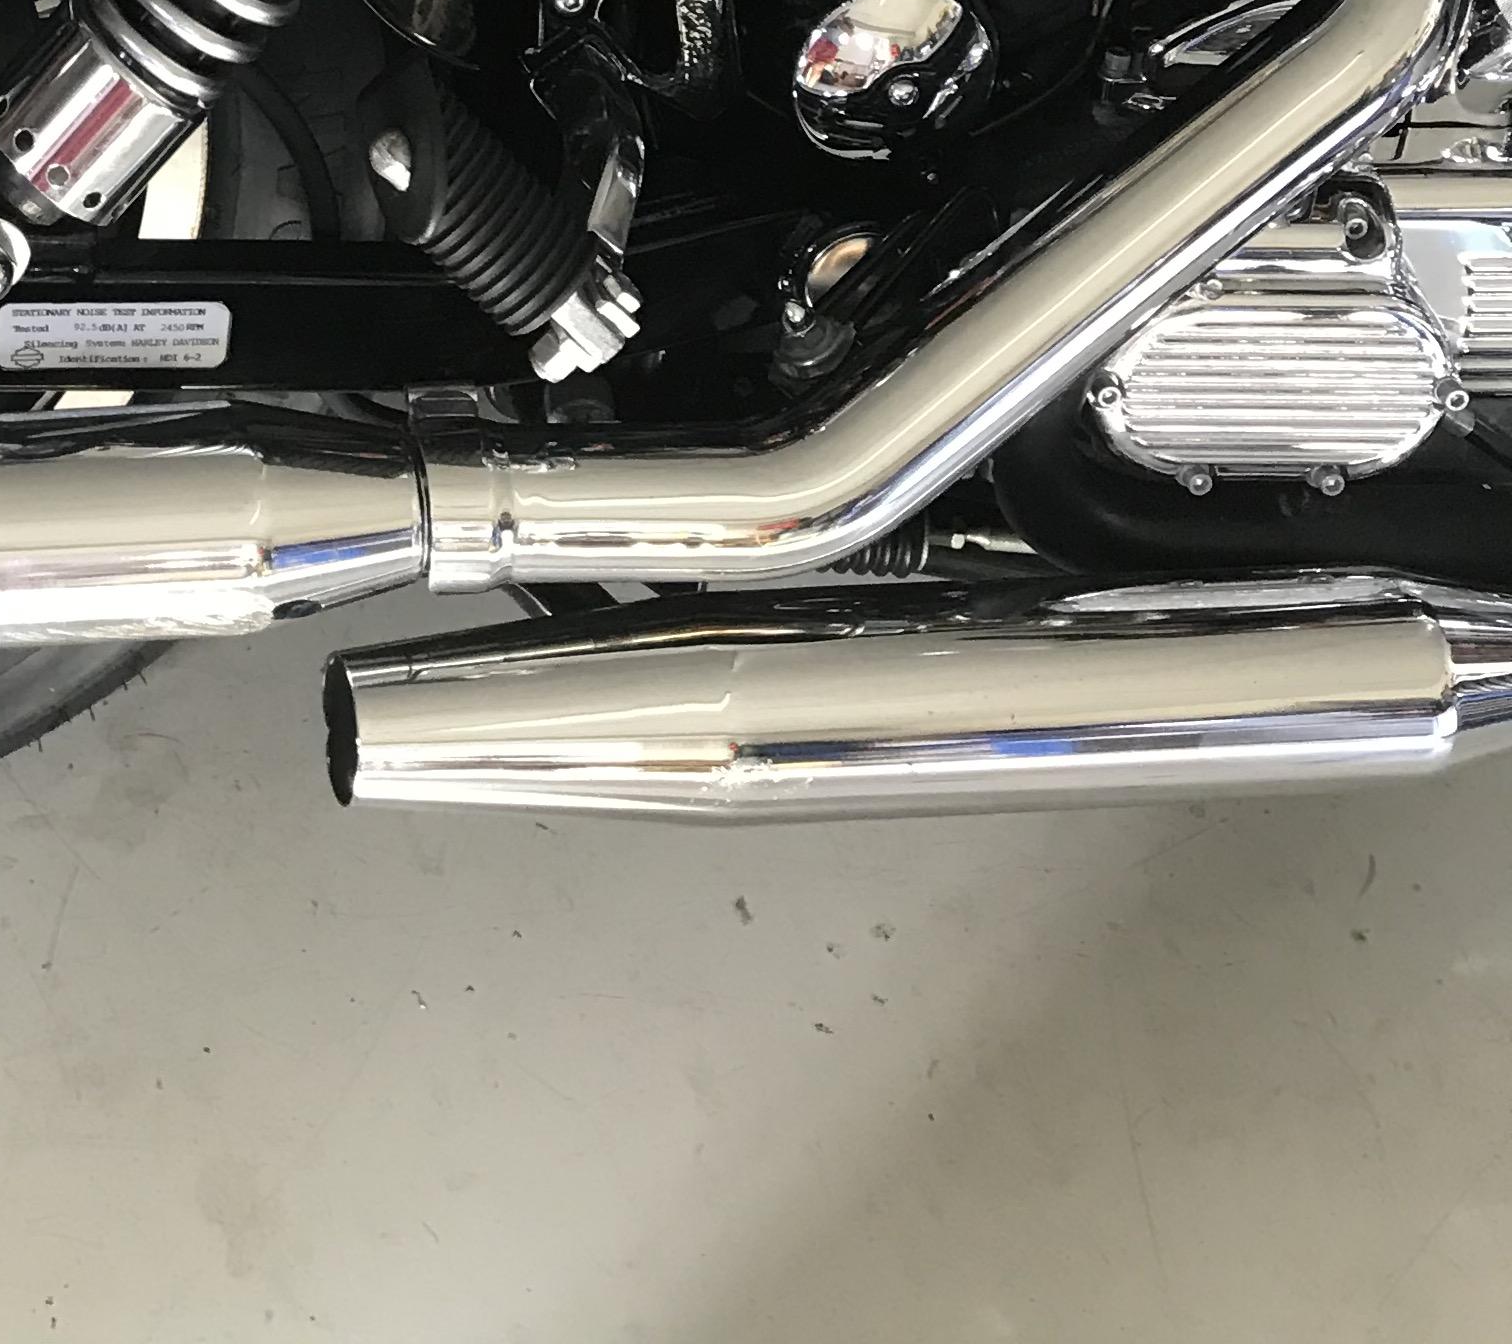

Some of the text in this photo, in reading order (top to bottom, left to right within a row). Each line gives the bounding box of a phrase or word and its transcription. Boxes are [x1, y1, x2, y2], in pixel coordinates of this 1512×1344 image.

[12, 308, 207, 317] STATIONARY NOISE TEST INFORMATION
[12, 324, 49, 333] Tested
[24, 340, 78, 349] Silencing
[131, 338, 168, 347] HARLEY
[172, 338, 220, 347] DAVIDSON
